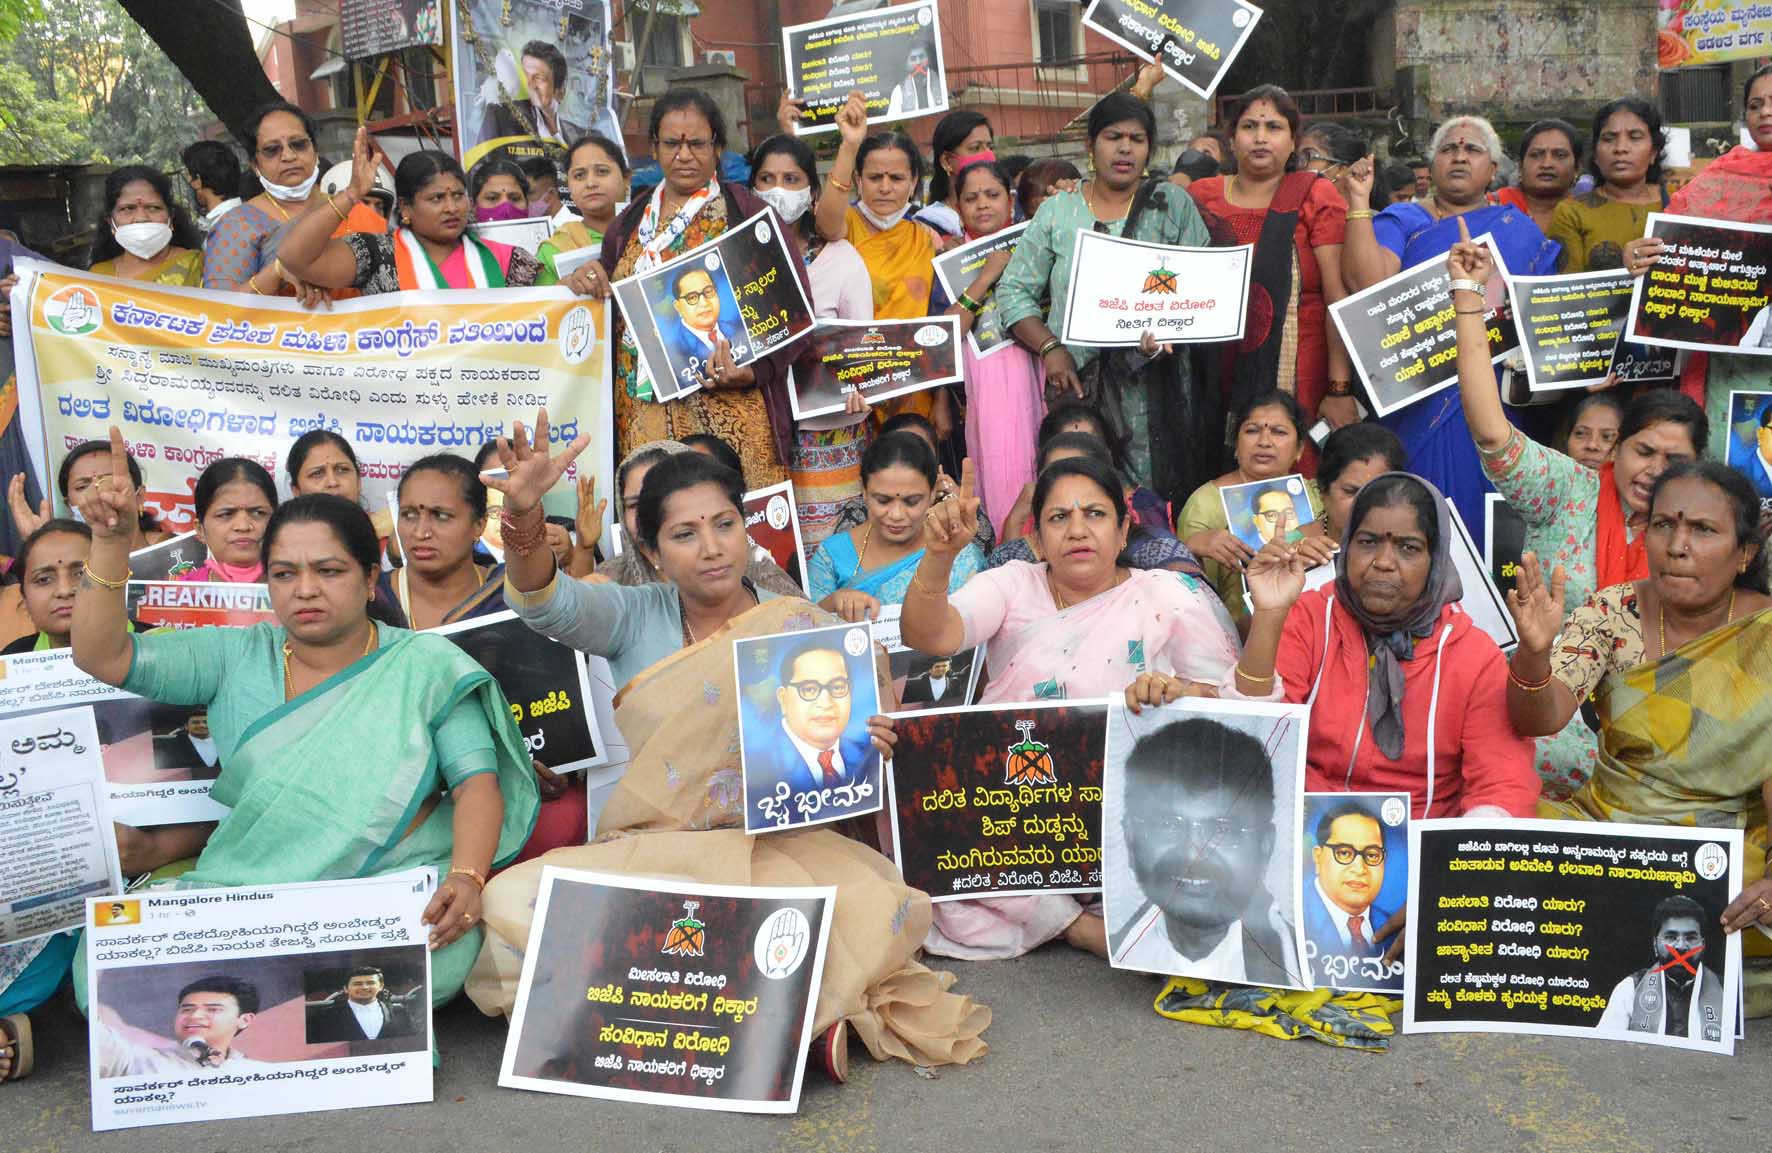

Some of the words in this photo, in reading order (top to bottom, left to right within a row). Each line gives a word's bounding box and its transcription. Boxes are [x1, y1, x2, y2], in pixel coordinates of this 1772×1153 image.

[113, 302, 205, 336] ಕರ್ನಾಟಕ
[208, 321, 276, 345] ಪ್ರದೇಶ
[282, 329, 349, 351] ಮಹಿಳಾ
[358, 320, 438, 356] ಕಾಂಗ್ರೆಸ್
[449, 316, 548, 344] ವತಿಯಿಂದ
[58, 394, 111, 419] ದಲಿತ
[123, 399, 277, 435] ವಿರೋಧಿಗಳಾದ
[758, 781, 791, 827] ಜೈ
[795, 776, 873, 822] ಭೀಮ್
[923, 788, 967, 811] ದಲಿತ
[973, 783, 1072, 815] ವಿದ್ಯಾರ್ಥಿಗಳ
[981, 815, 1016, 837] ಶಿಪ್
[1024, 813, 1088, 842] ದುಡ್ಡನ್ನು
[937, 844, 1054, 871] ನುಂಗಿರುವವರು
[1449, 859, 1505, 872] ಮಾತಾಡುವ
[1510, 860, 1554, 873] ಅವಿವೇಕಿ
[1560, 862, 1603, 878] ಛಲವಾದಿ
[1608, 866, 1697, 889] ನಾರಾಯಣಸ್ವಾಮಿ
[148, 895, 222, 908] Mangalore
[225, 891, 274, 902] Hindus
[1438, 895, 1489, 909] ಮೀಸಲಾತಿ
[1493, 895, 1538, 910] ವಿರೋಧಿ
[1542, 898, 1586, 913] ಯಾರು?
[96, 933, 168, 948] ಸಾವರ್ಕರ್
[173, 922, 319, 942] ದೇಶದ್ರೋಹಿಯಾಗಿದ್ದರೆ
[323, 916, 401, 932] ಅಂಬೇಡ್ಕರ್
[1437, 919, 1487, 933] ಸಂವಿಧಾನ
[1491, 919, 1535, 935] ವಿರೋಧಿ
[1540, 922, 1582, 937] ಯಾರು?
[96, 948, 161, 962] ಯಾಕಲ್ಲ?
[166, 943, 207, 955] ಬಿಜೆಪಿ
[212, 939, 264, 952] ನಾಯಕ
[320, 932, 374, 944] ಸೂರ್ಯ
[1498, 944, 1542, 959] ವಿರೋಧಿ
[1546, 947, 1589, 961] ಯಾರು?
[628, 968, 679, 983] ಮೀಸಲಾತಿ
[684, 972, 726, 989] ವಿರೋಧಿ
[587, 986, 624, 1006] ಬಿಜೆಪಿ
[630, 992, 706, 1012] ನಾಯಕರಿಗೆ
[713, 998, 757, 1024] ಧಿಕ್ಕಾರ
[1426, 991, 1451, 1011] ತಮ್ಮ
[1456, 990, 1496, 1004] ಕೊಳಕು
[1500, 992, 1548, 1011] ಹೃದಯಕ್ಕೆ
[1552, 994, 1606, 1013] ಅರಿವಿಲ್ಲವೇ
[599, 1025, 667, 1048] ಸಂವಿಧಾನ
[673, 1031, 730, 1054] ವಿರೋಧಿ
[114, 1079, 183, 1094] ಸಾವರ್ಕರ್
[188, 1067, 328, 1088] ದೇಶದ್ರೋಹಿಯಾಗಿದ್ದರೆ
[332, 1062, 405, 1078] ಅಂಬೇಡ್ಕರ್
[594, 1055, 622, 1071] ಬಿಜೆಪಿ
[628, 1059, 686, 1077] ನಾಯಕರಿಗೆ
[690, 1063, 724, 1085] ಧಿಕ್ಕಾರ
[114, 1092, 175, 1105] ಯಾಕಲ್ಲ?
